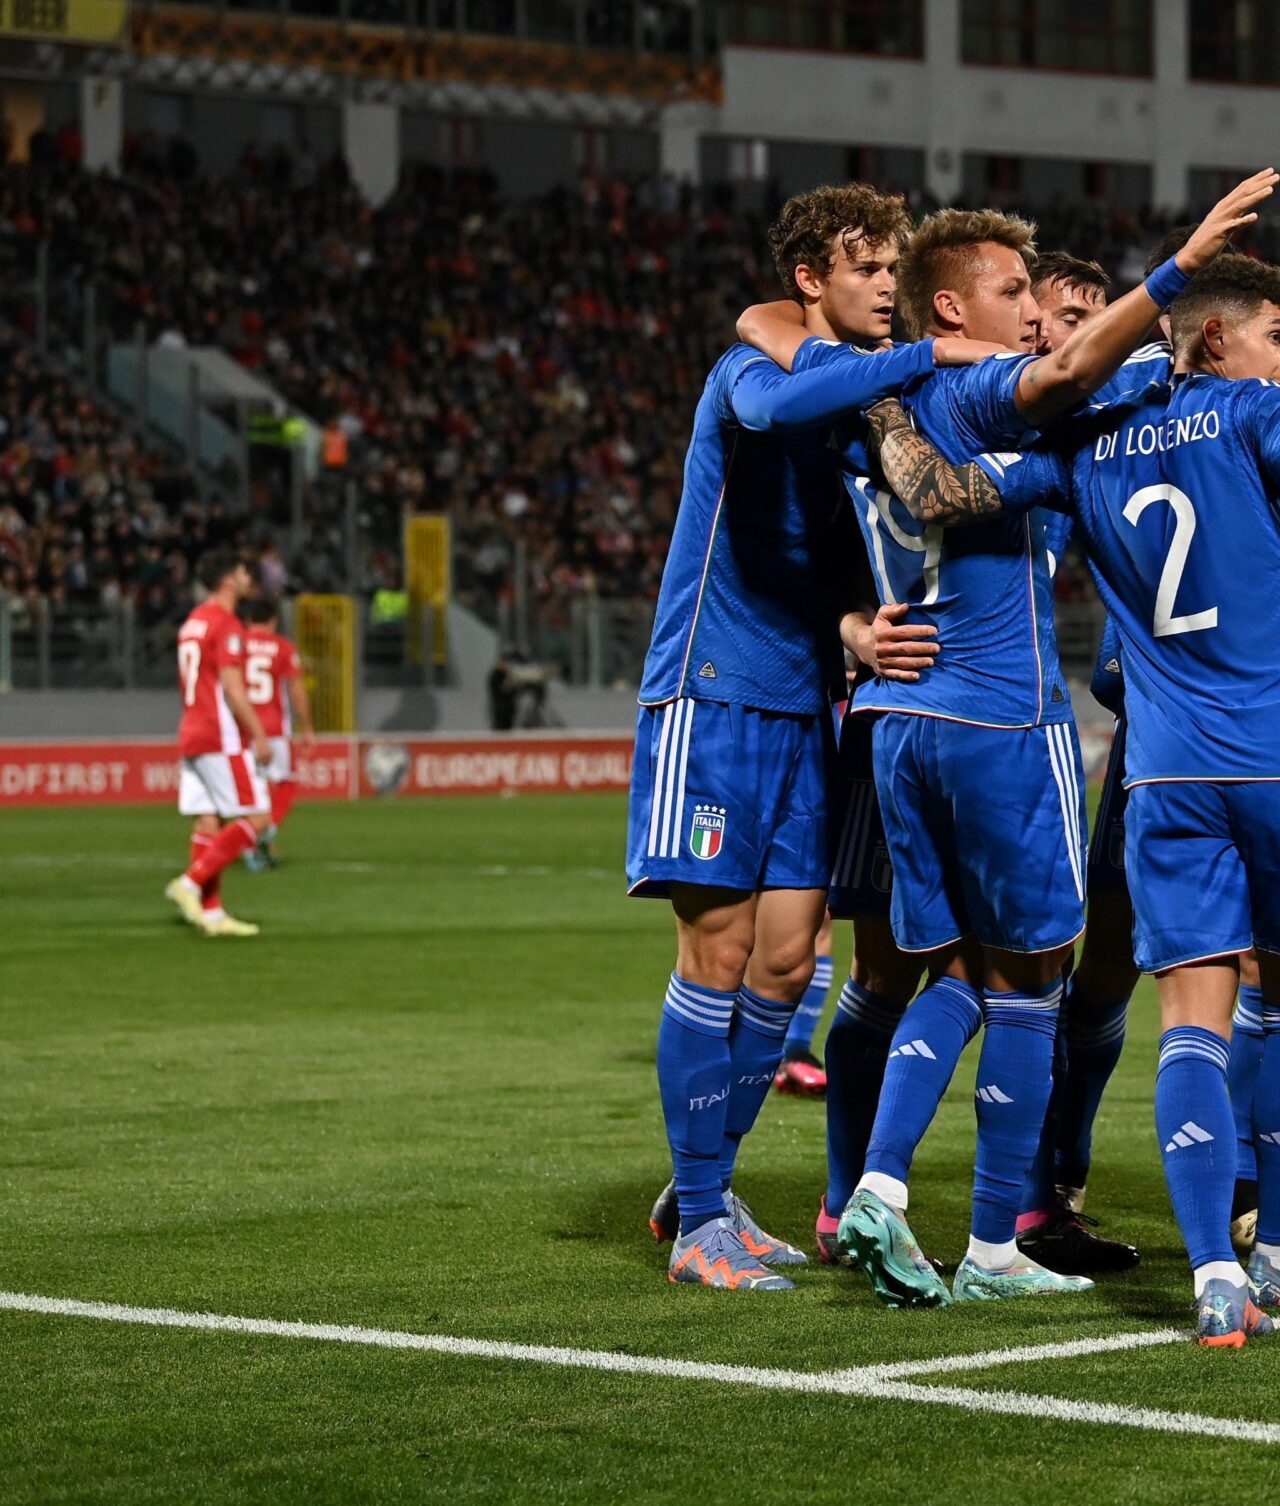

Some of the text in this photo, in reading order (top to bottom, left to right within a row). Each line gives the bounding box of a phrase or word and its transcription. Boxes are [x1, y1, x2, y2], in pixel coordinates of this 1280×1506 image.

[1094, 431, 1118, 461] DI
[1122, 484, 1218, 637] 2
[246, 655, 273, 705] 5
[415, 751, 632, 788] EUROPEAN QUAL
[695, 816, 721, 828] ITALIA
